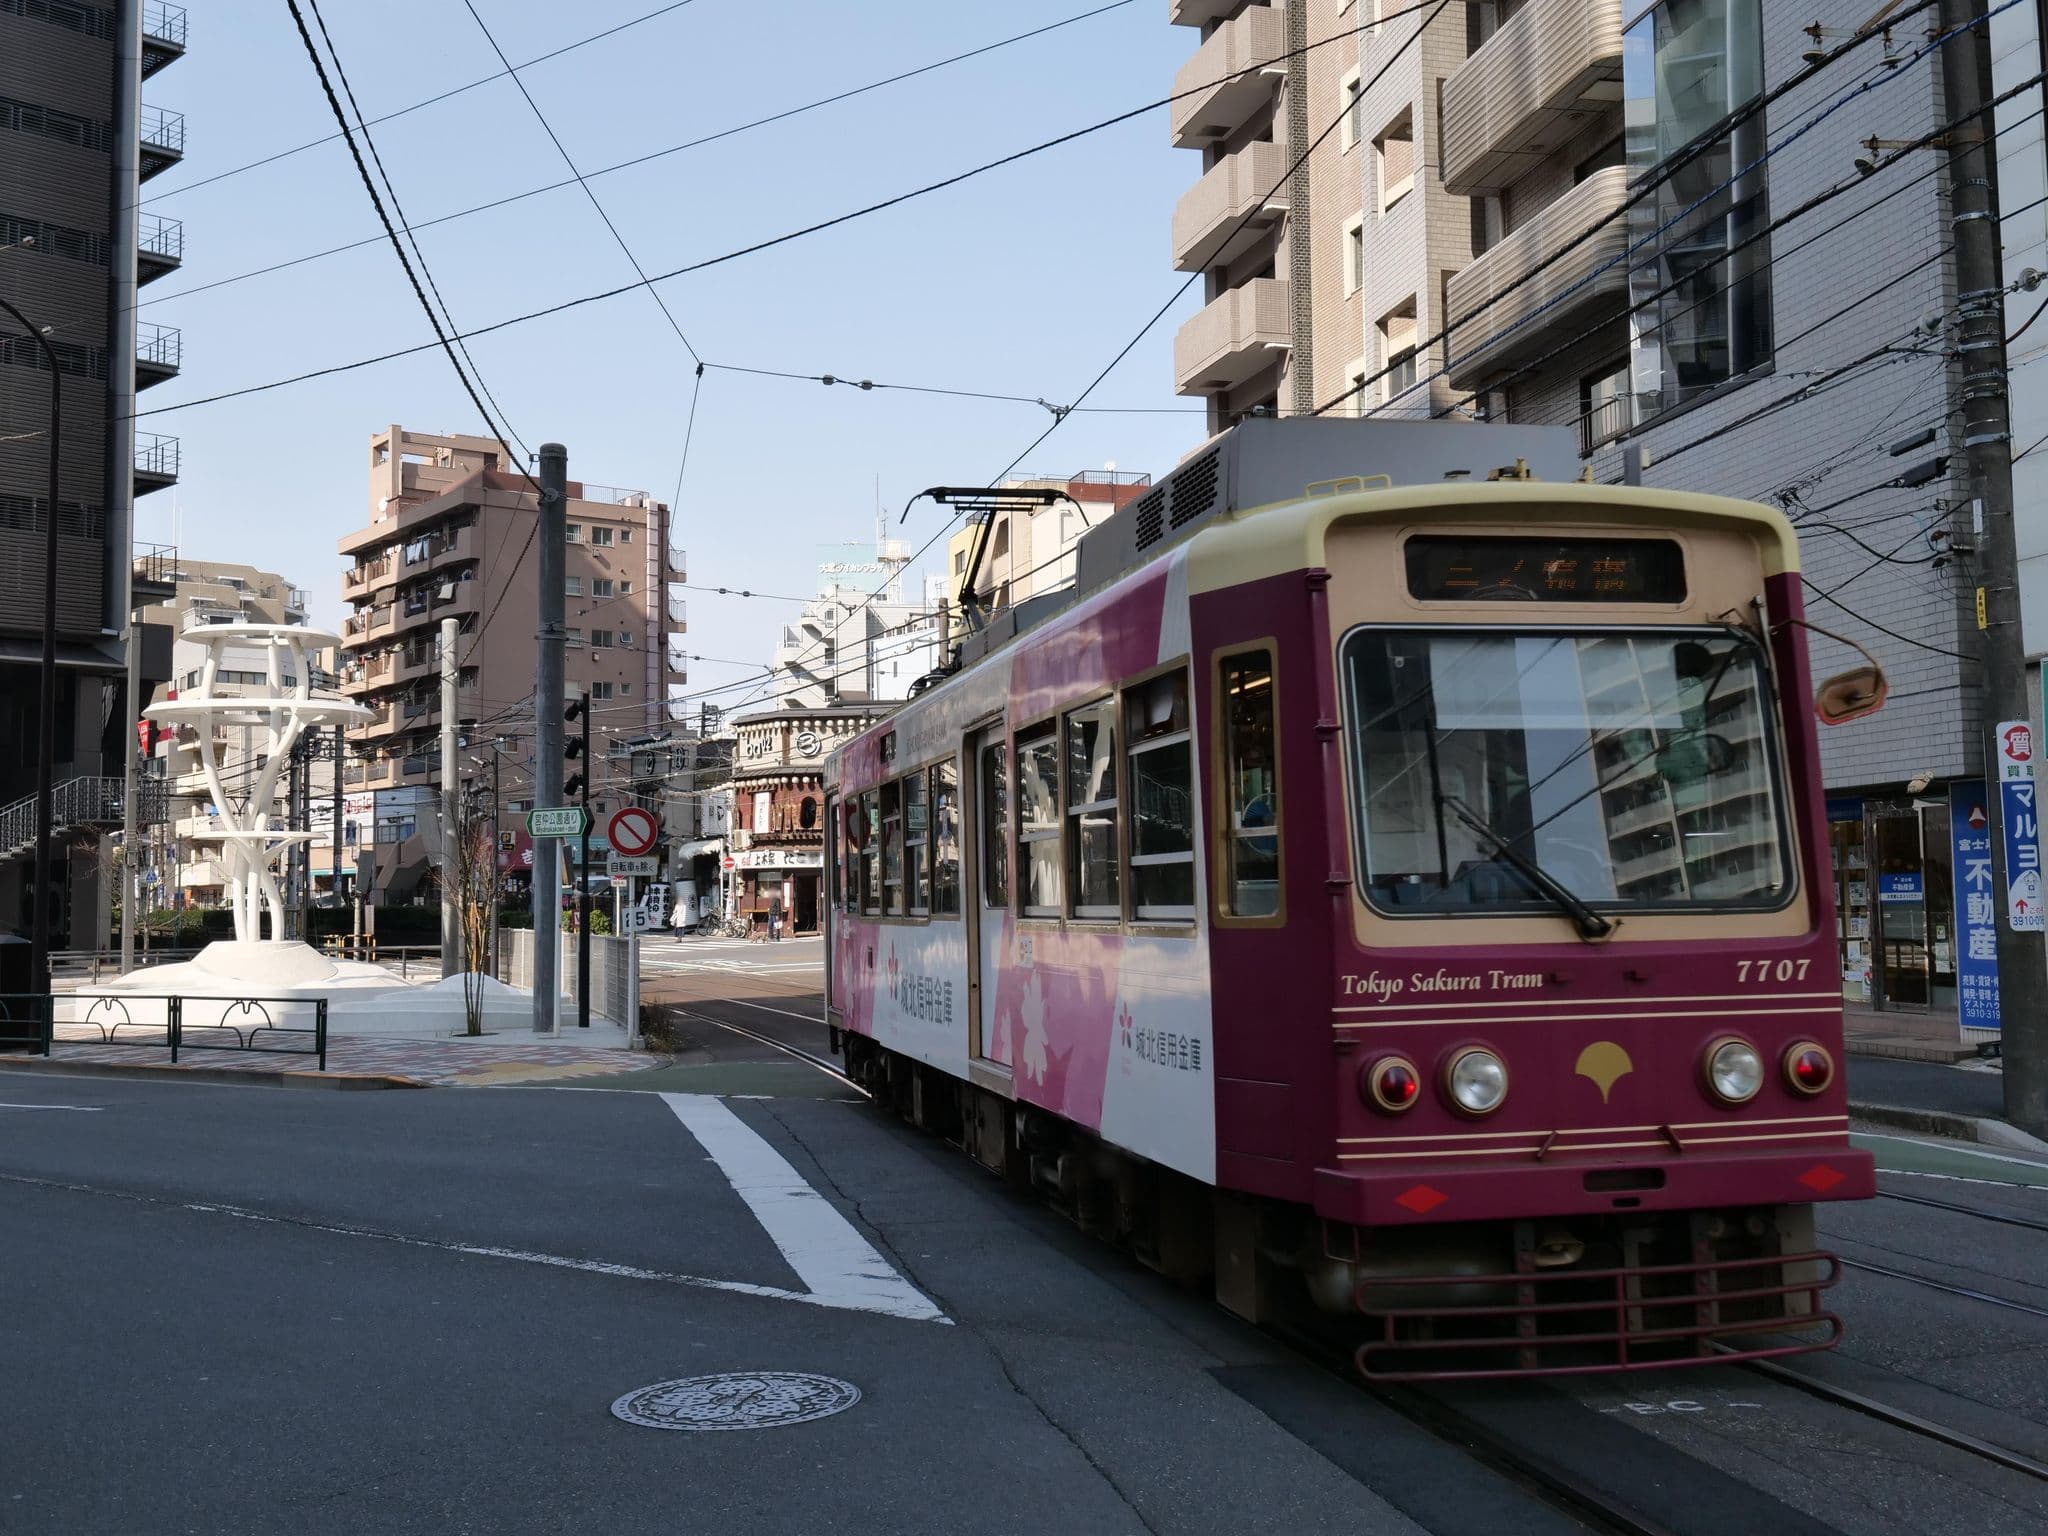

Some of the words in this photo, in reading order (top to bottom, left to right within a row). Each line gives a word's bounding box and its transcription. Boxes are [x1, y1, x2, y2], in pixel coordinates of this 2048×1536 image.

[610, 861, 655, 873] 自転車を除く
[1964, 858, 1998, 960] 不動産
[1341, 973, 1404, 1003] Tokyo
[1409, 969, 1481, 993] Sakura
[1487, 969, 1544, 990] Tram
[1736, 959, 1812, 983] 7707
[900, 976, 953, 1028] 城北信用金庫
[1135, 1028, 1202, 1074] 城北信用金庫
